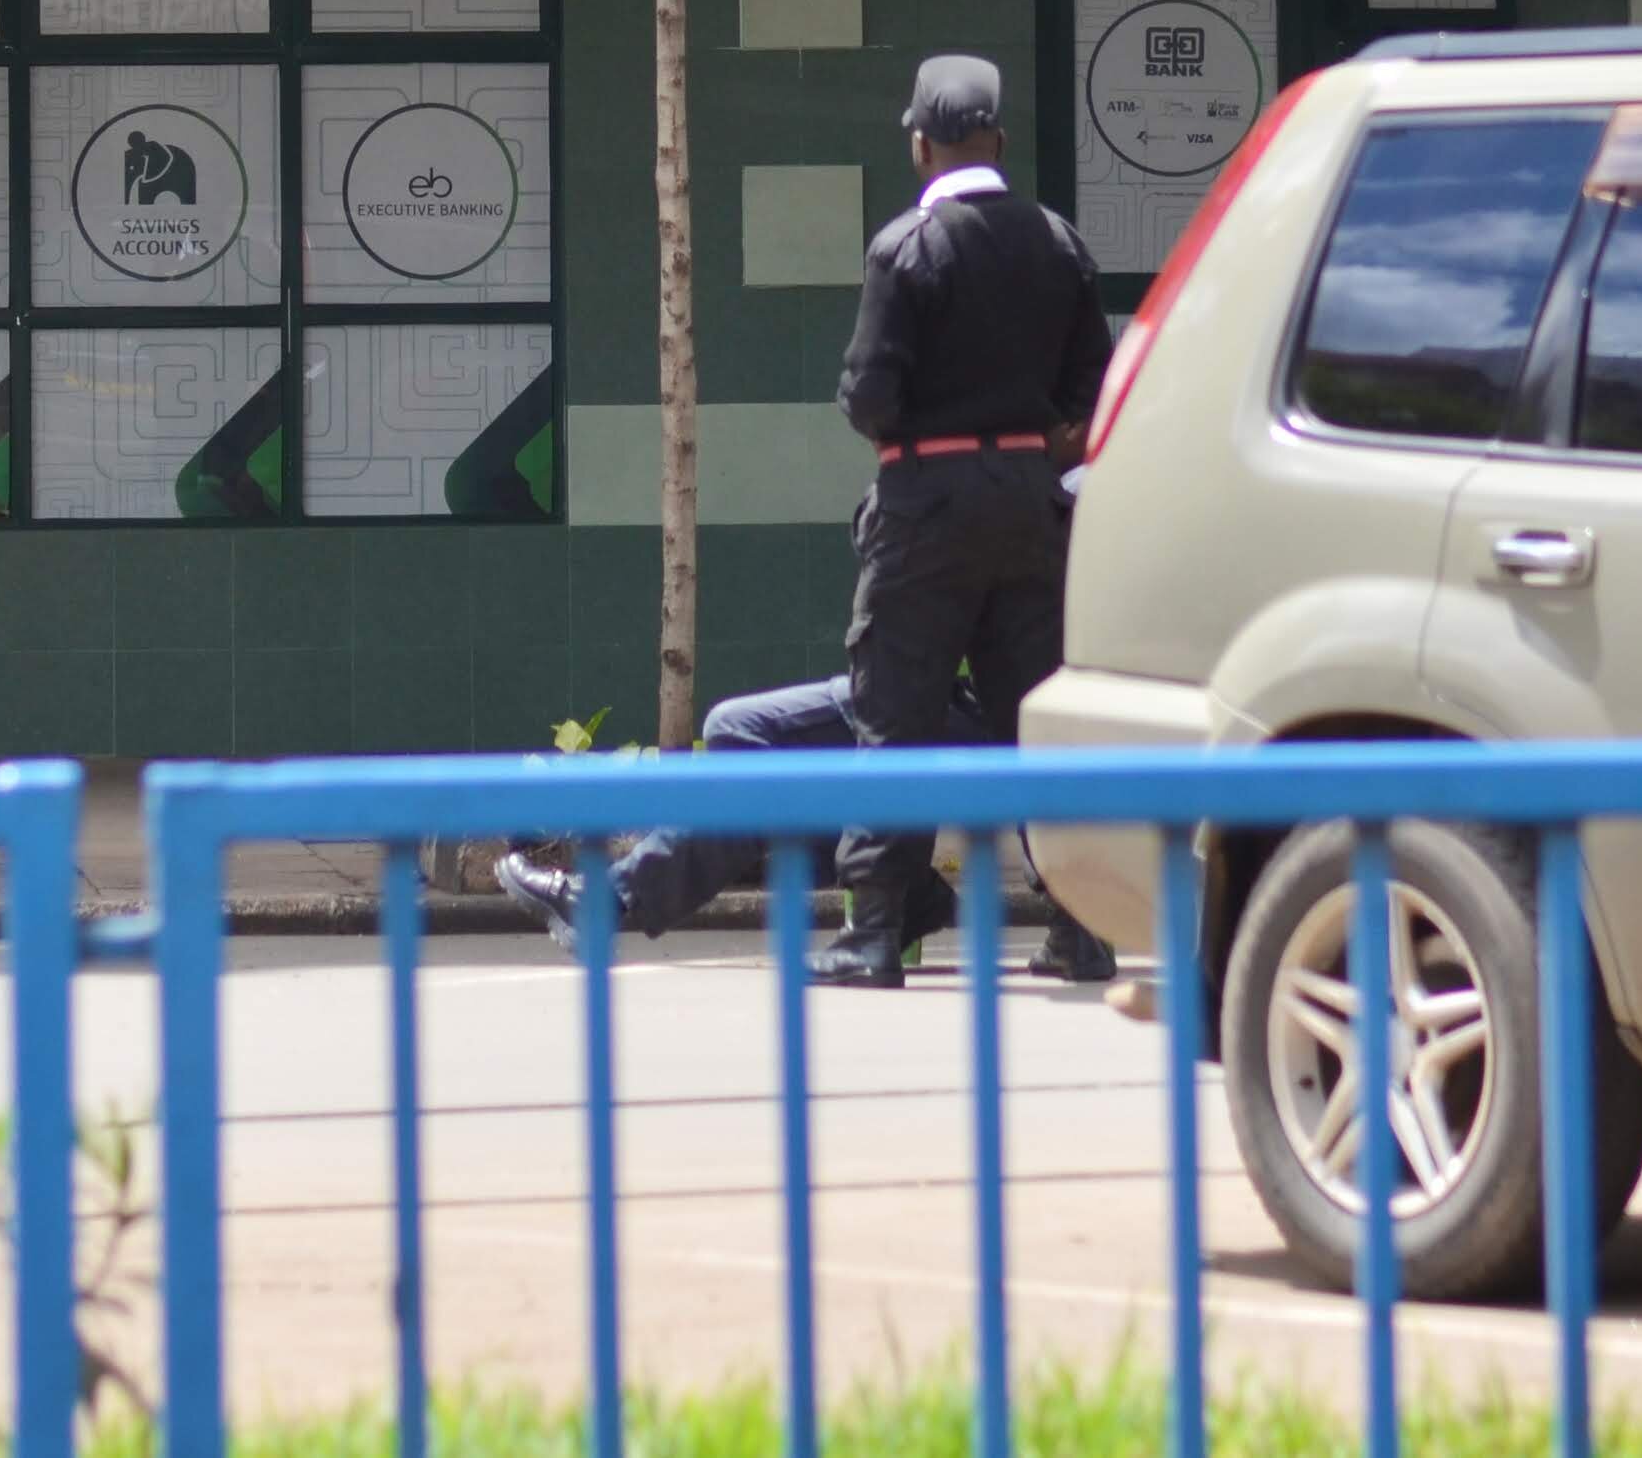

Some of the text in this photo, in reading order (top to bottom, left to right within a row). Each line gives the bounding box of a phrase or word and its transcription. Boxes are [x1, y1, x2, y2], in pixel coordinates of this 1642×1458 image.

[1145, 64, 1204, 77] BANK
[1107, 101, 1136, 113] ATM
[1186, 133, 1214, 144] VISA
[357, 203, 504, 217] EXECUTIVE BANKING
[121, 218, 201, 235] SAVINGS
[111, 239, 210, 256] ACCOUNTS
